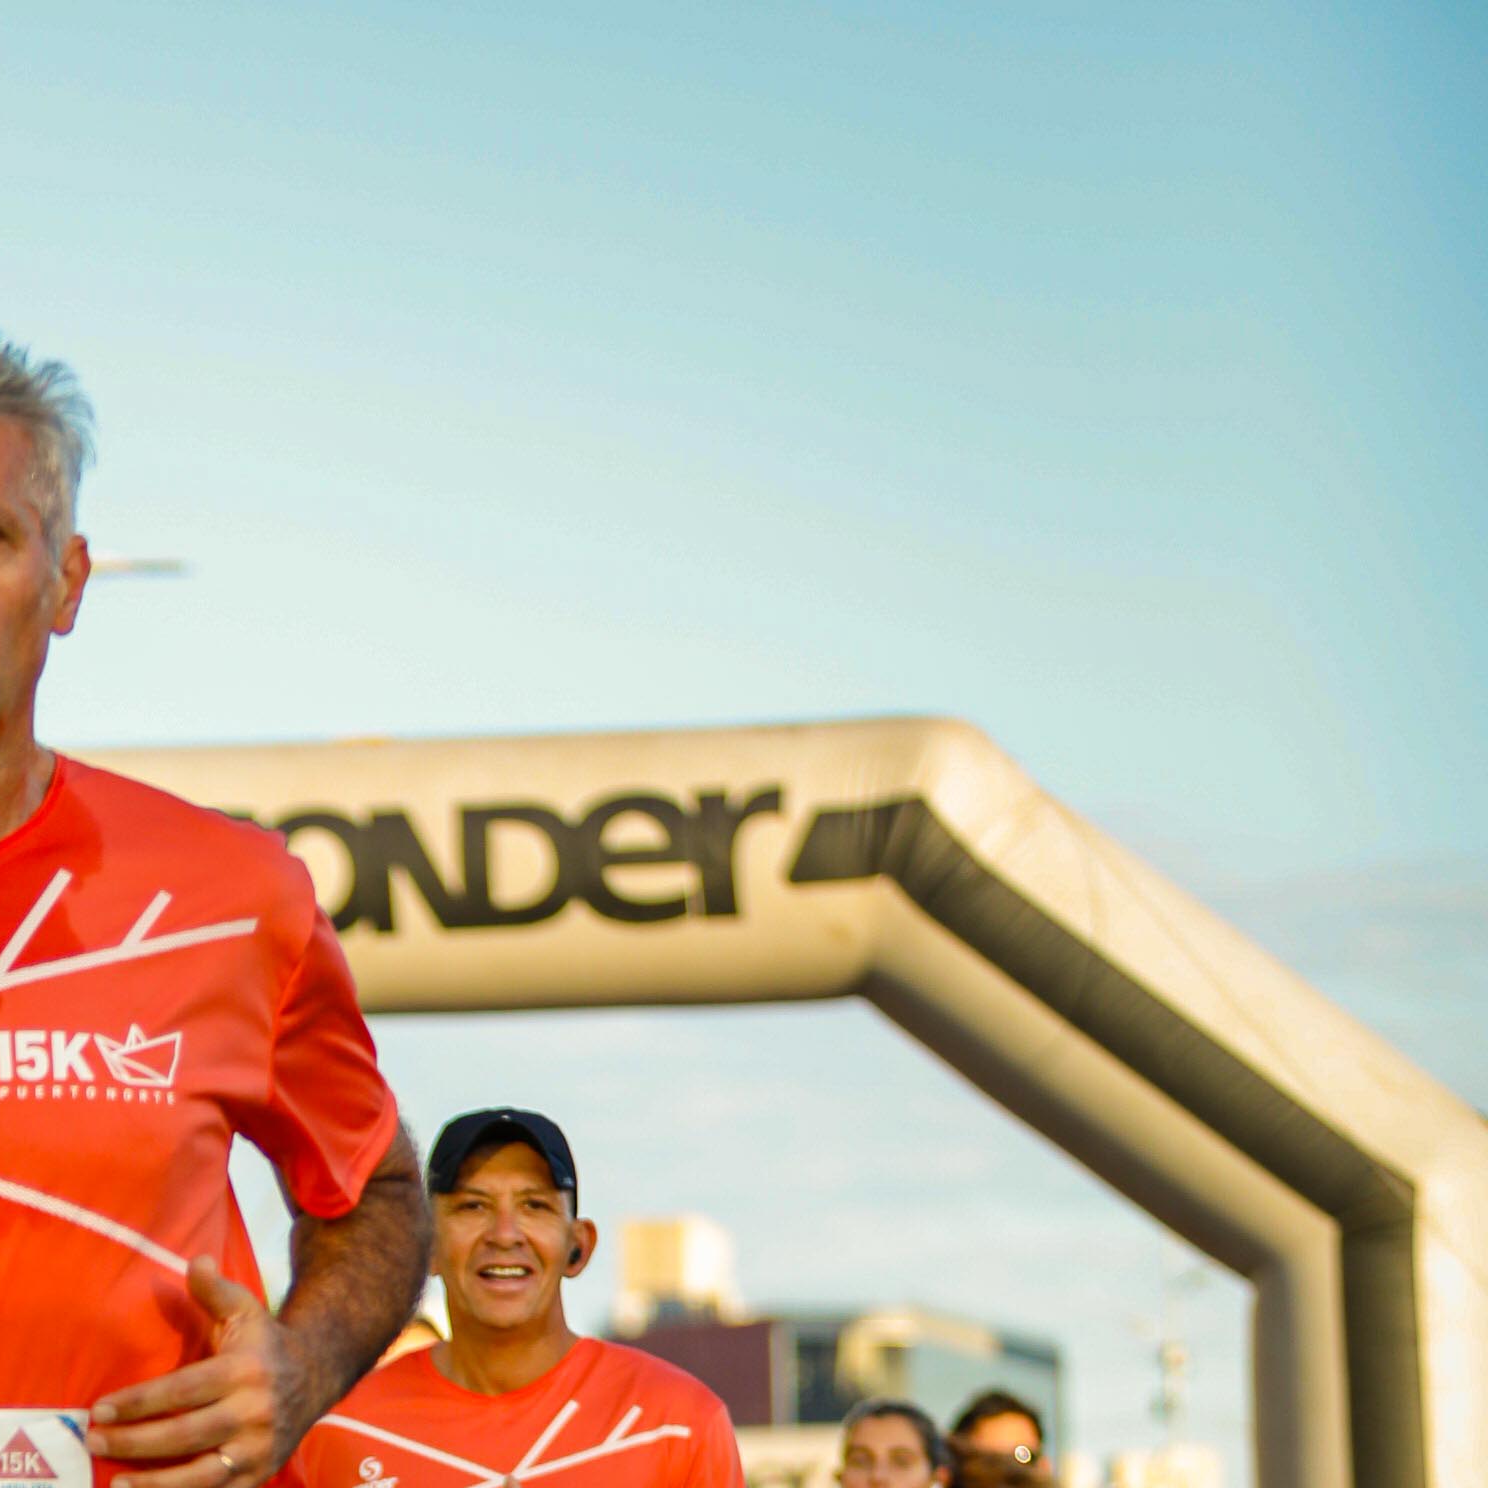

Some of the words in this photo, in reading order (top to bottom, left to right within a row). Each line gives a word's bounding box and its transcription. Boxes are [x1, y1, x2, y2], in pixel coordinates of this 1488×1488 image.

[0, 1084, 97, 1100] PUERTO
[105, 1086, 176, 1105] NORTE
[1, 1451, 41, 1473] 15K
